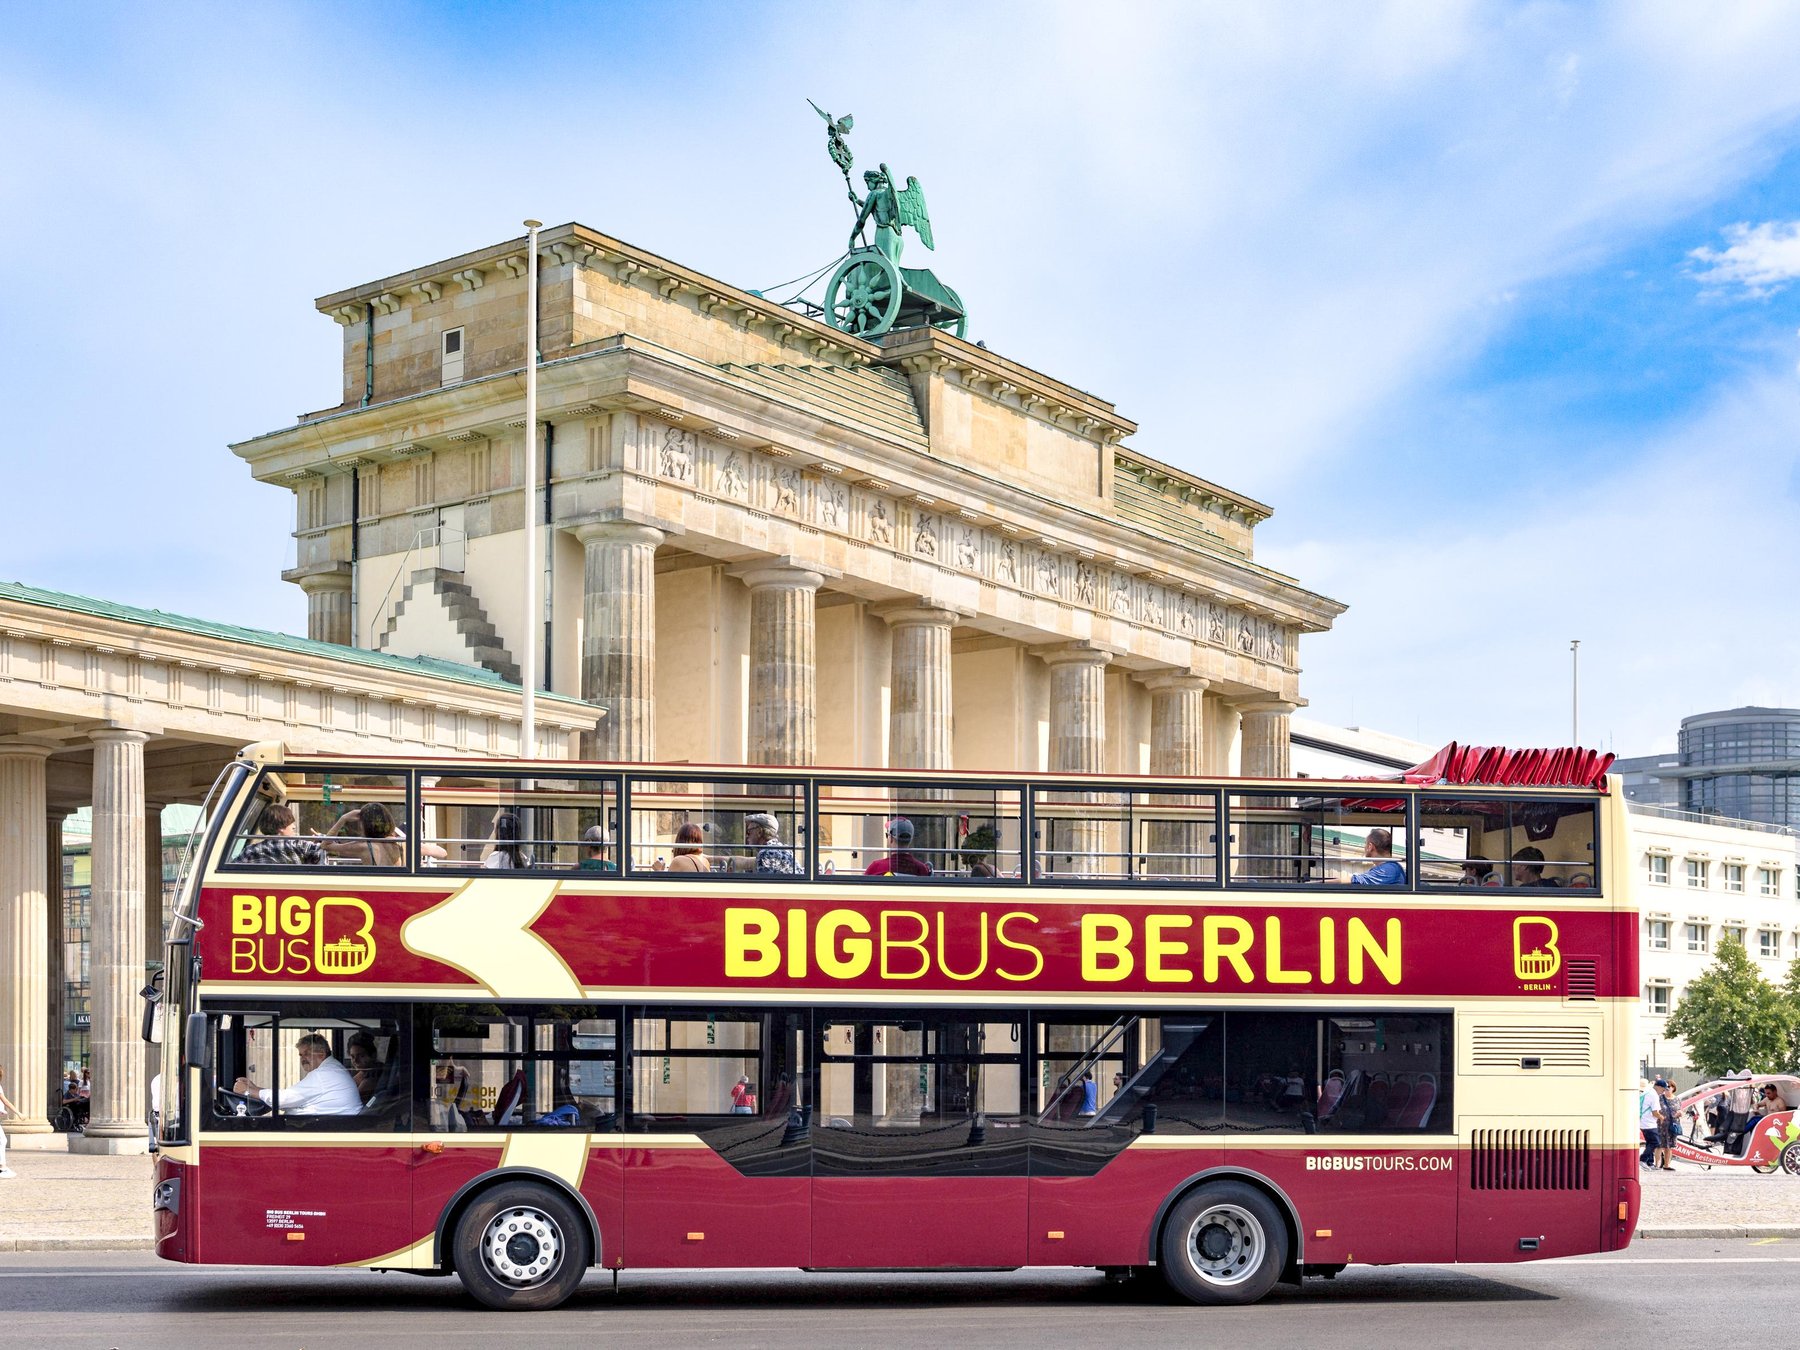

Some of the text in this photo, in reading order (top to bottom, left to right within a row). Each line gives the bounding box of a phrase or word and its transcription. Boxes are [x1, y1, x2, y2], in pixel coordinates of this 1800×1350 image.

[231, 895, 312, 936] BIG
[231, 938, 311, 975] BUS
[1081, 913, 1402, 985] BERLIN
[1523, 983, 1551, 991] BERLIN
[1305, 1156, 1453, 1171] BIGBUSTOURS.COM
[1695, 1153, 1728, 1164] Restaurant
